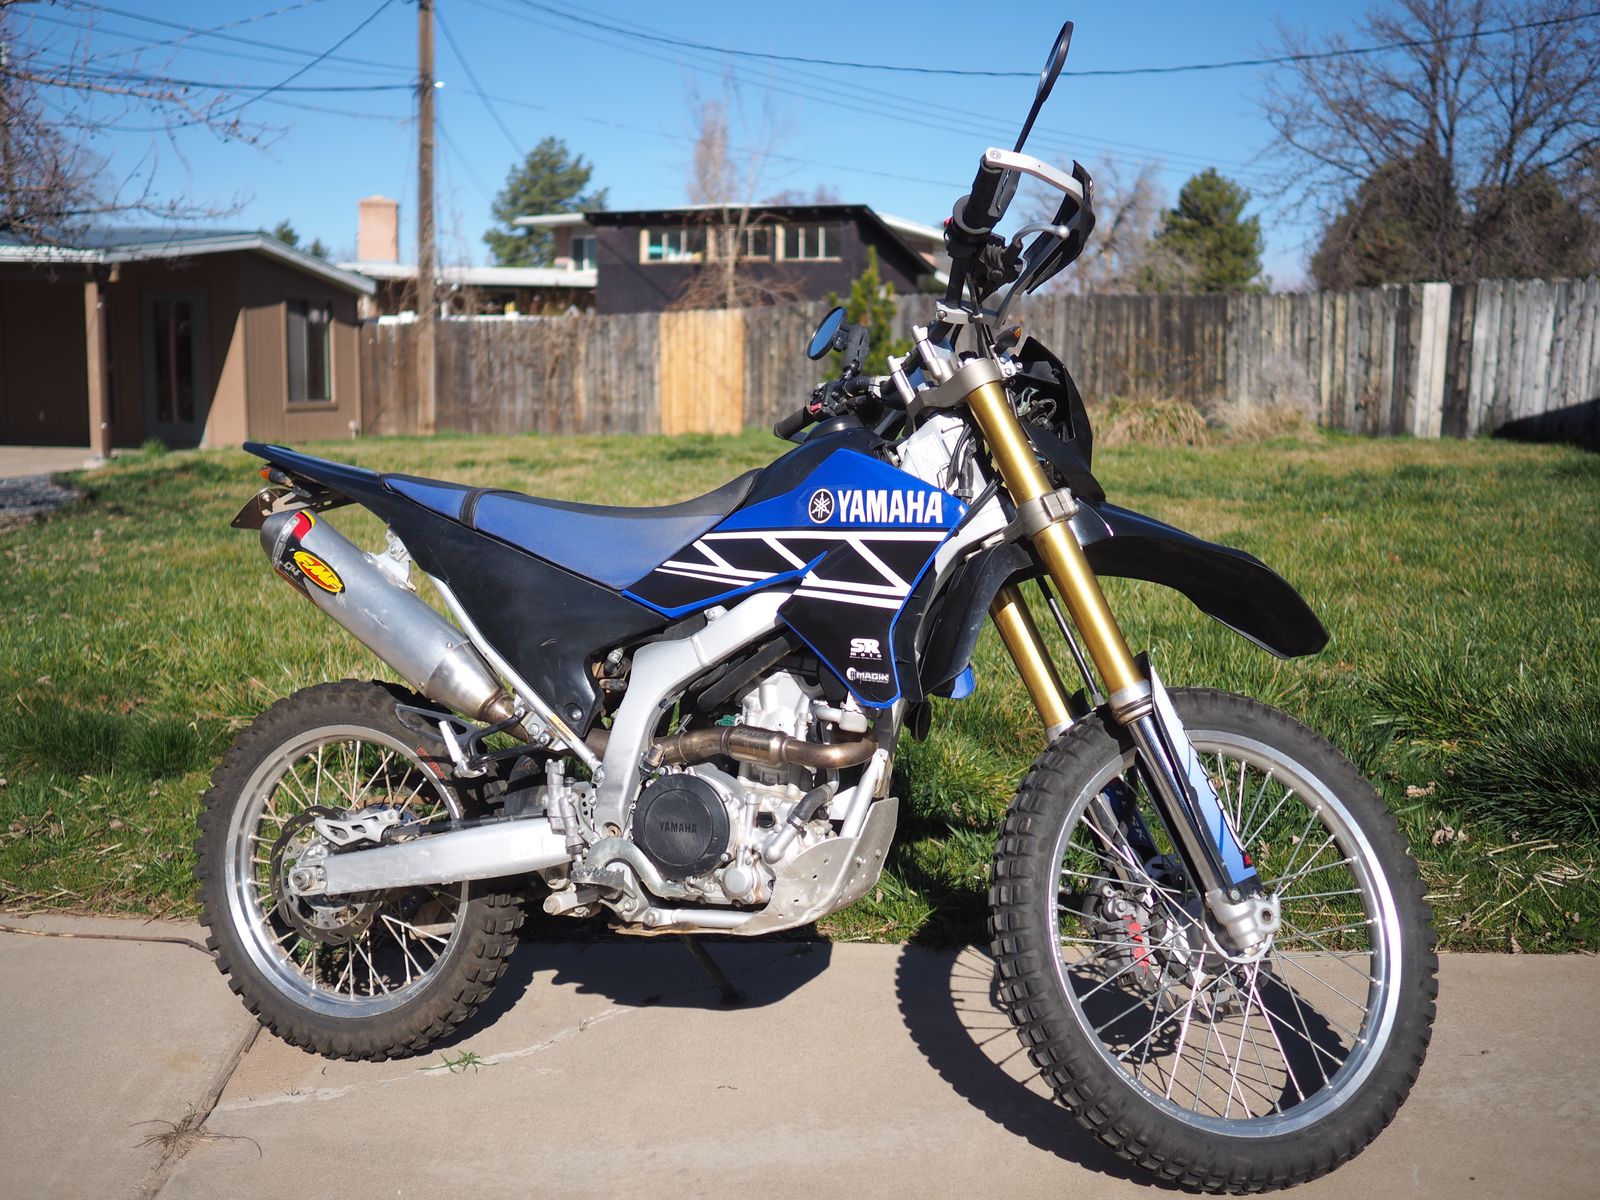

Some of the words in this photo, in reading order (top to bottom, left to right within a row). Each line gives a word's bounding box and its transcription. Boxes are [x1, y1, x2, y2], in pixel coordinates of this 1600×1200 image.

[837, 489, 944, 524] YAMAHA
[293, 552, 343, 589] FMF
[850, 638, 881, 654] SR
[659, 821, 697, 833] YAMAHA
